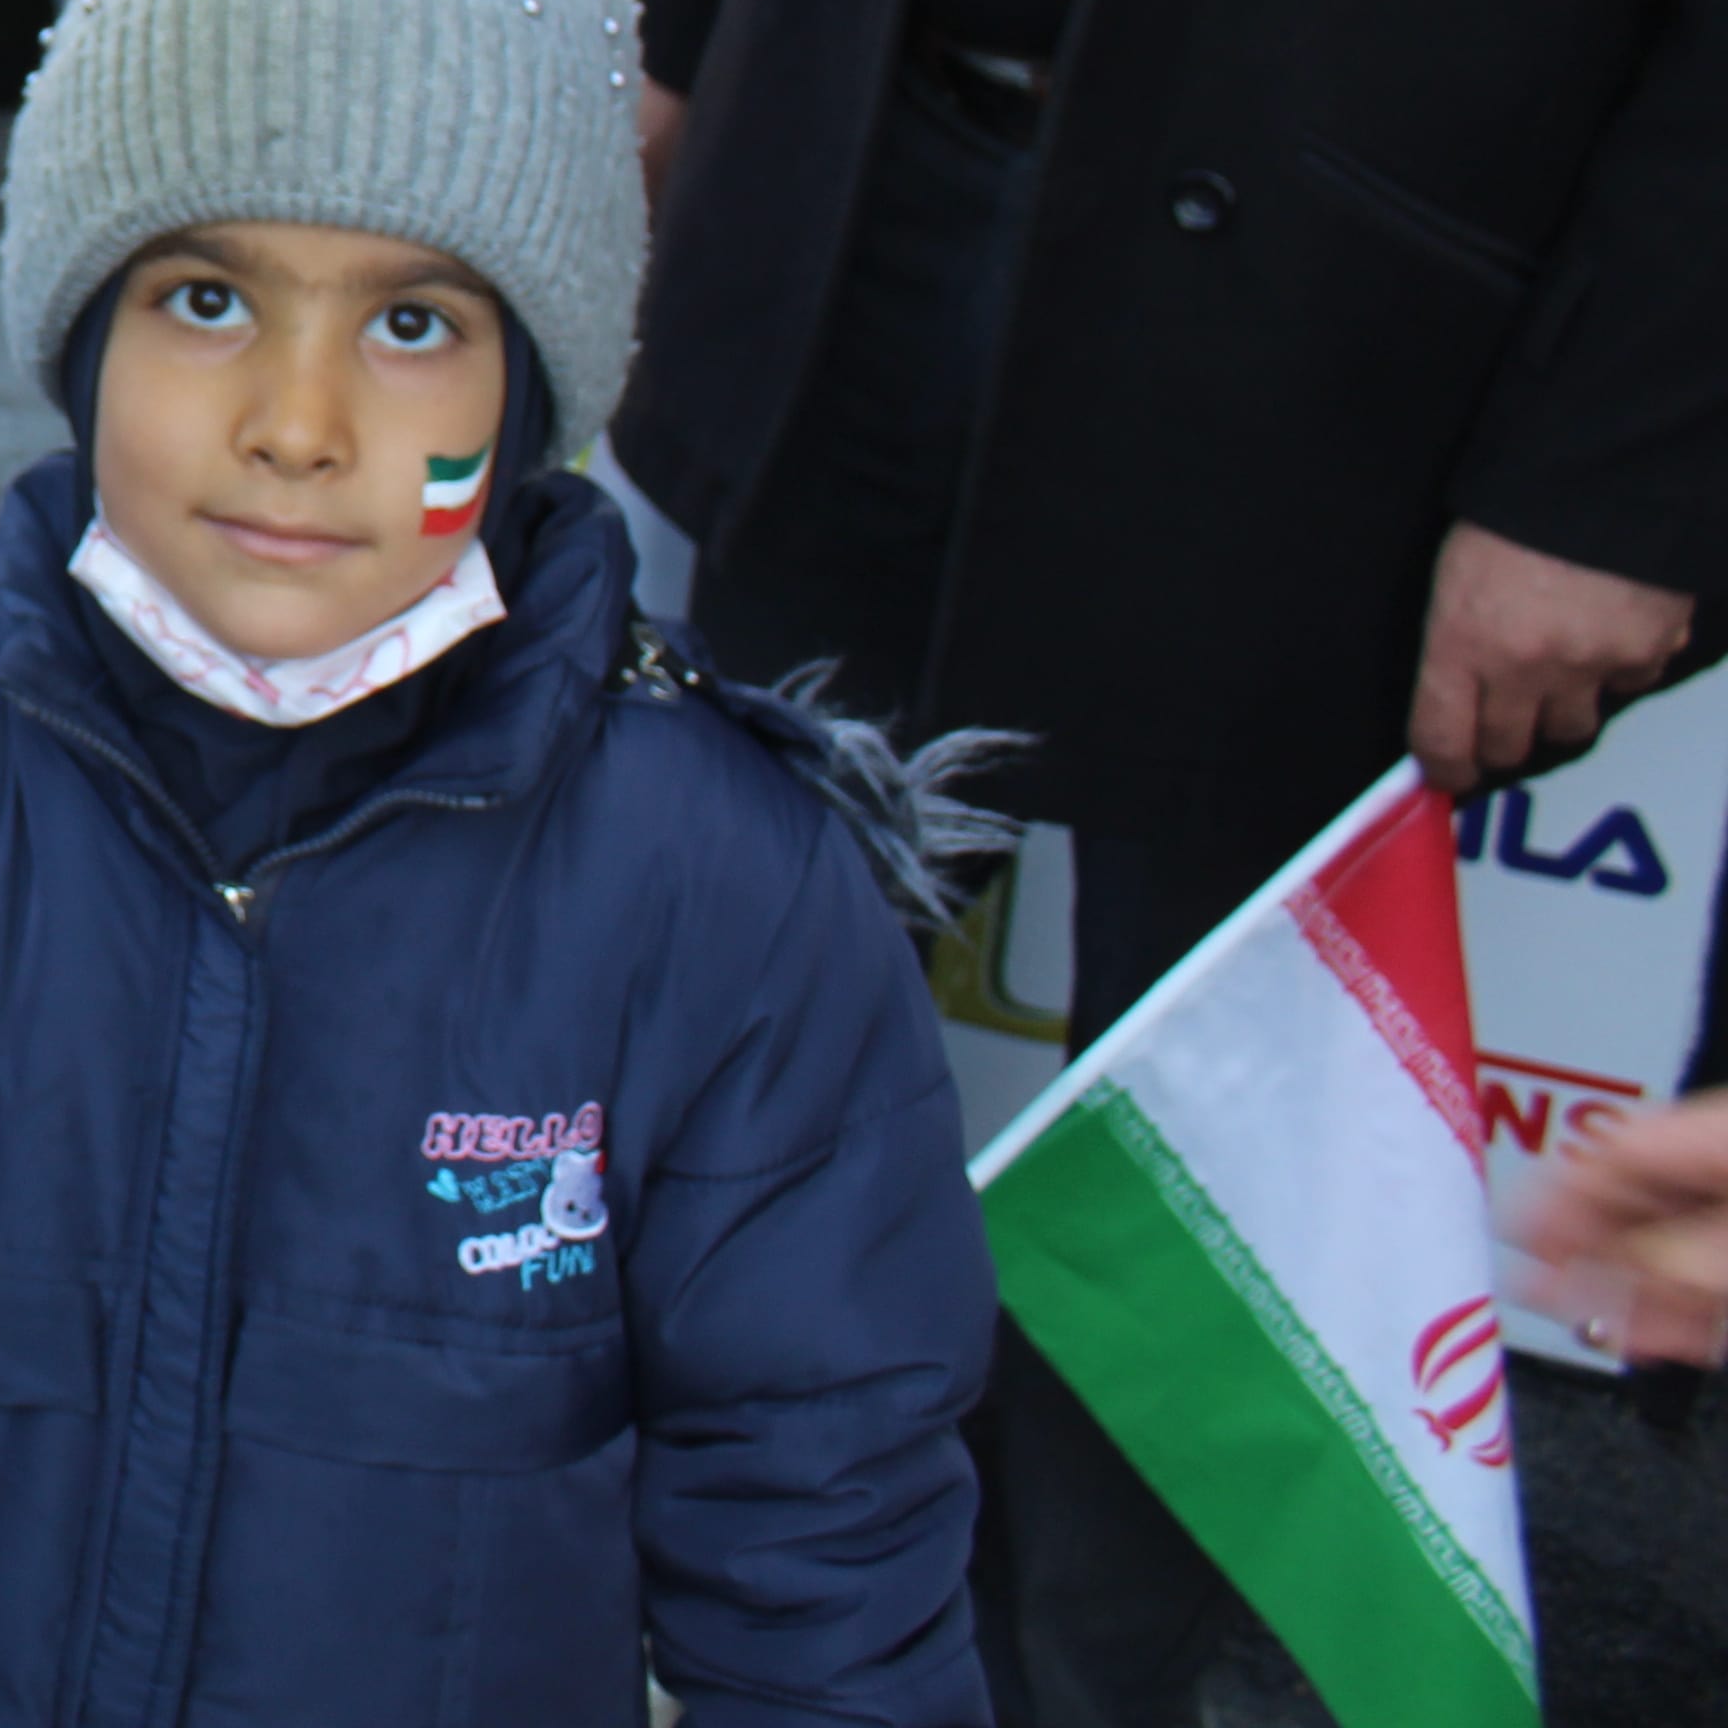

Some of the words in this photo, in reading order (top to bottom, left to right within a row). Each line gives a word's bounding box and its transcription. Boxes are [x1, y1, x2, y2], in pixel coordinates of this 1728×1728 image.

[1457, 784, 1670, 899] ILA
[421, 1101, 603, 1160] HELLO
[520, 1242, 596, 1292] FUN
